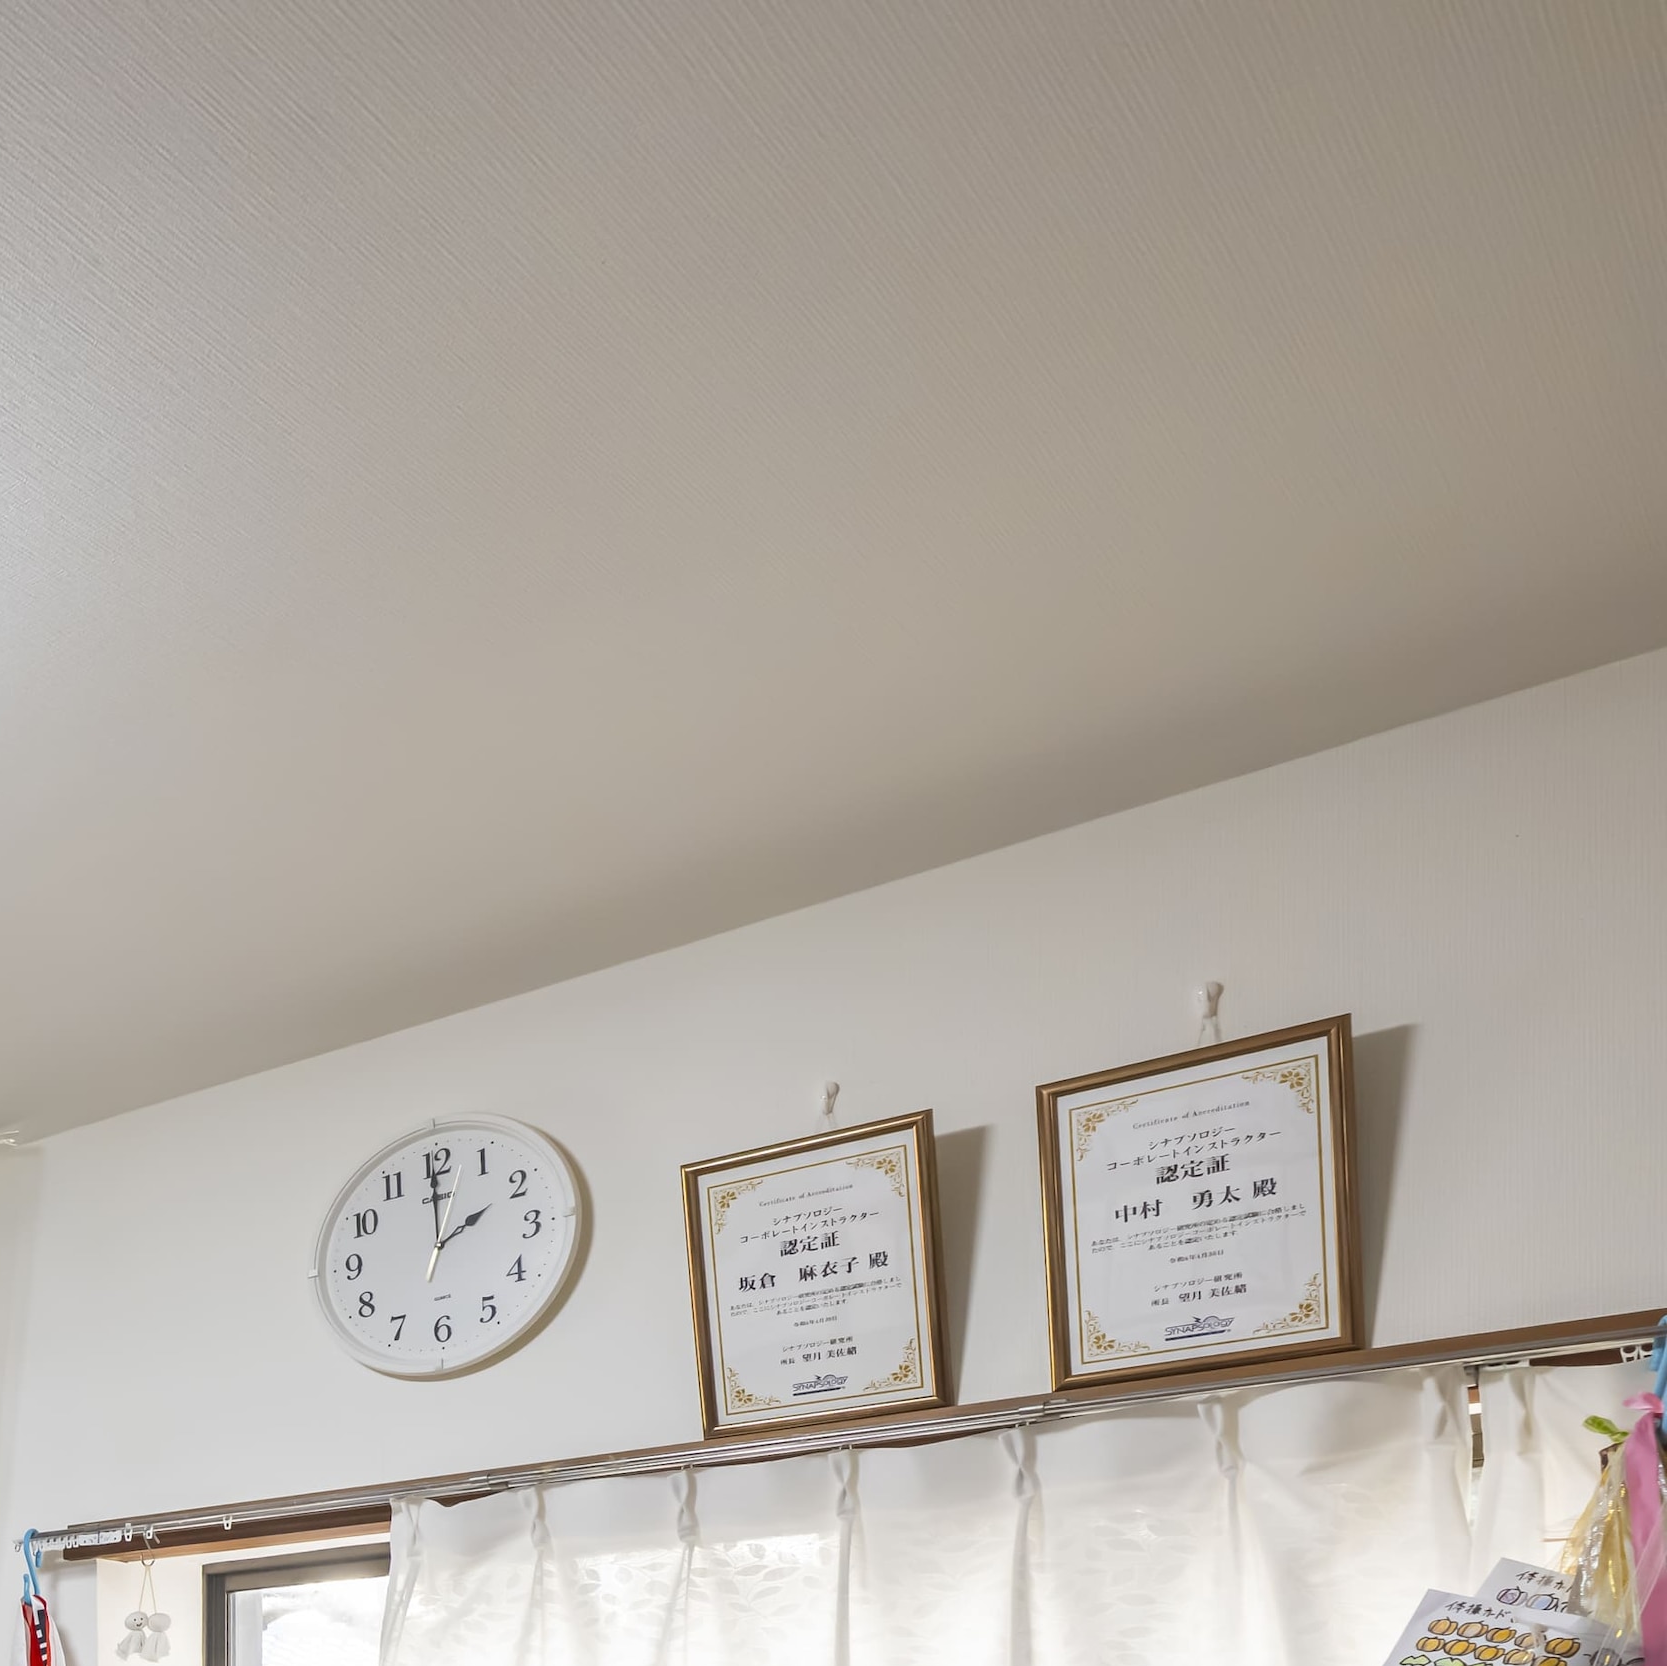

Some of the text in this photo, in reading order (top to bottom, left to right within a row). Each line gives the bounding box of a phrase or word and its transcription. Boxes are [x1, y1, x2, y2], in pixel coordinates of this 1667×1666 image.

[1132, 1116, 1178, 1130] Certificate
[1192, 1100, 1250, 1117] Accreditation
[1106, 1131, 1282, 1172] コーポレートインストラクター
[1148, 1125, 1236, 1151] シナプソロジー
[422, 1147, 453, 1180] 12
[476, 1147, 490, 1177] 1
[1156, 1153, 1231, 1185] 認定証
[381, 1171, 406, 1202] 11
[508, 1169, 529, 1200] 2
[1114, 1177, 1278, 1224] 中村 勇太 殿
[352, 1208, 379, 1240] 10
[522, 1209, 542, 1239] 3
[740, 1210, 881, 1245] コーポレートインストラクター
[772, 1206, 844, 1227] シナプソロジー
[779, 1230, 841, 1258] 認定証
[345, 1253, 363, 1281] 9
[505, 1253, 528, 1283] 4
[738, 1250, 890, 1293] 坂倉 麻衣子 殿
[358, 1291, 376, 1319] 8
[479, 1295, 498, 1323] 5
[389, 1314, 407, 1341] 7
[433, 1315, 452, 1343] 6
